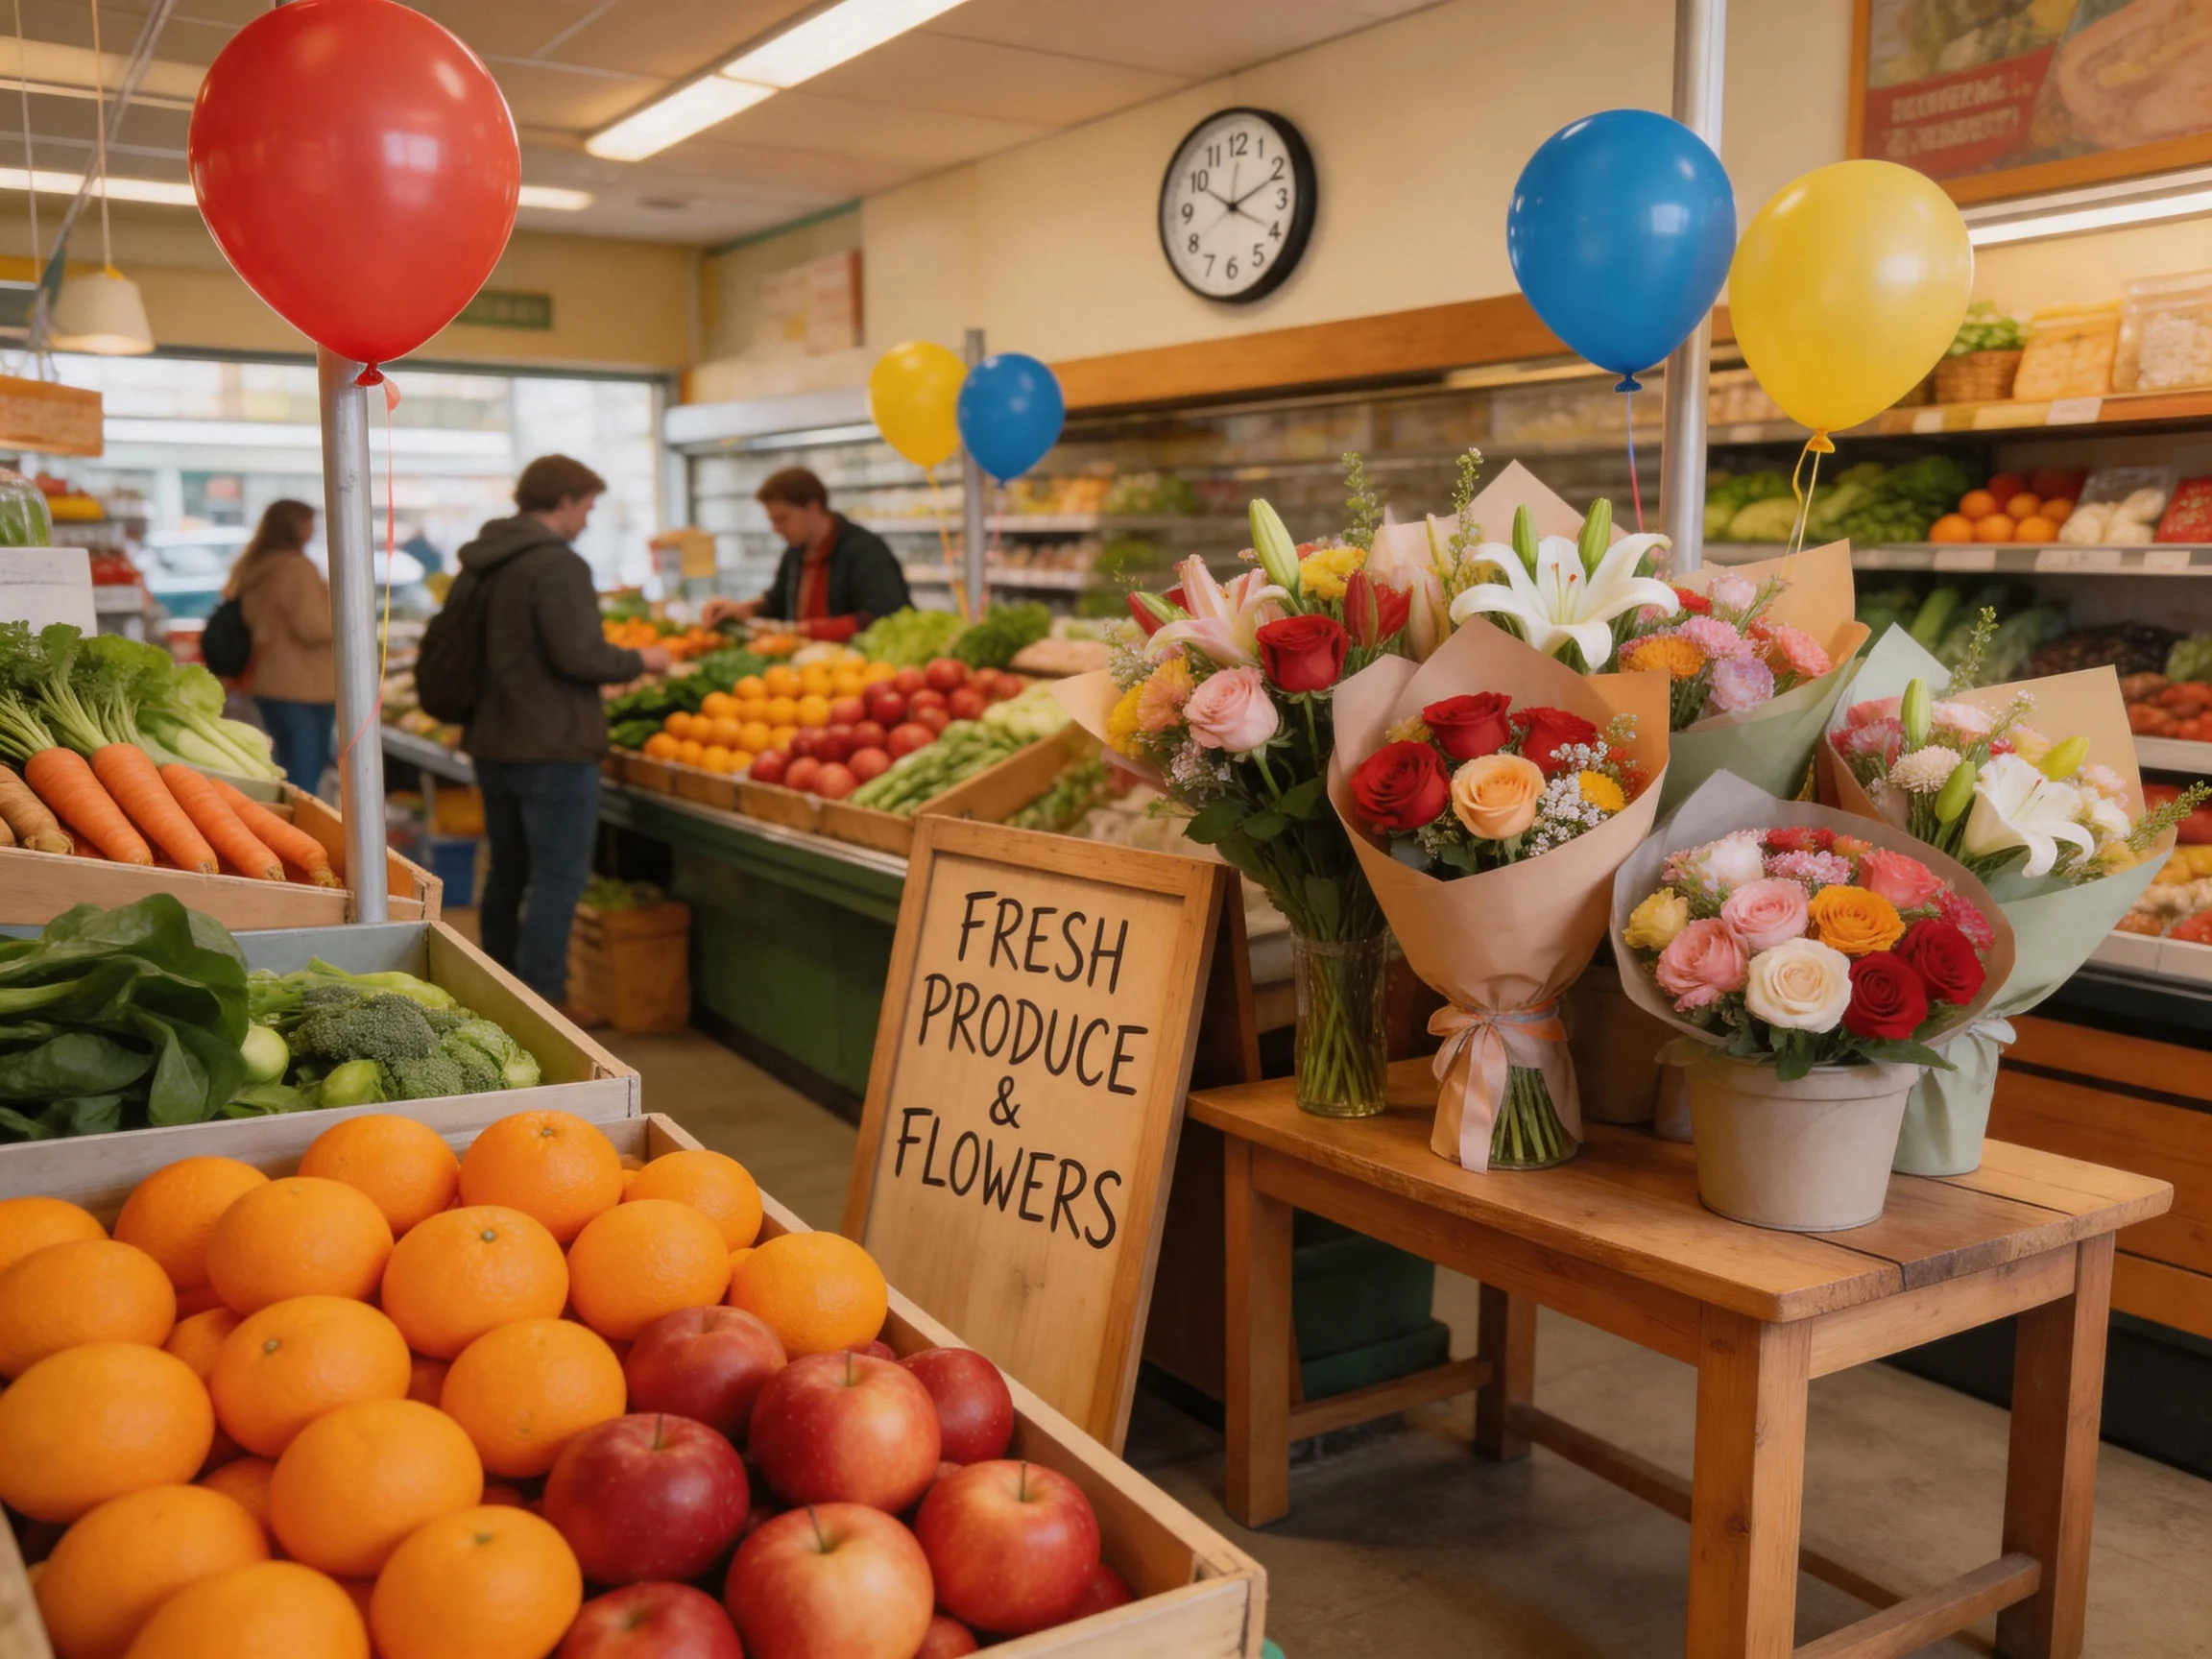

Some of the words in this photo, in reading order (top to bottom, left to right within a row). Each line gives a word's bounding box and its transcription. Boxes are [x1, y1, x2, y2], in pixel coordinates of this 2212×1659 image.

[1206, 144, 1221, 168] 11
[1228, 132, 1248, 157] 12
[1258, 136, 1263, 158] 1
[1271, 156, 1285, 180] 2
[1190, 169, 1209, 193] 10
[1275, 188, 1287, 210] 3
[1182, 204, 1193, 225] 9
[1268, 221, 1282, 240] 4
[1188, 233, 1199, 253] 8
[1252, 243, 1264, 267] 5
[1203, 254, 1215, 277] 7
[1226, 255, 1238, 279] 6
[957, 890, 1129, 995] FRESH
[918, 973, 1149, 1096] PRODUCE
[989, 1075, 1021, 1129] &
[894, 1107, 1122, 1250] FLOWERS
